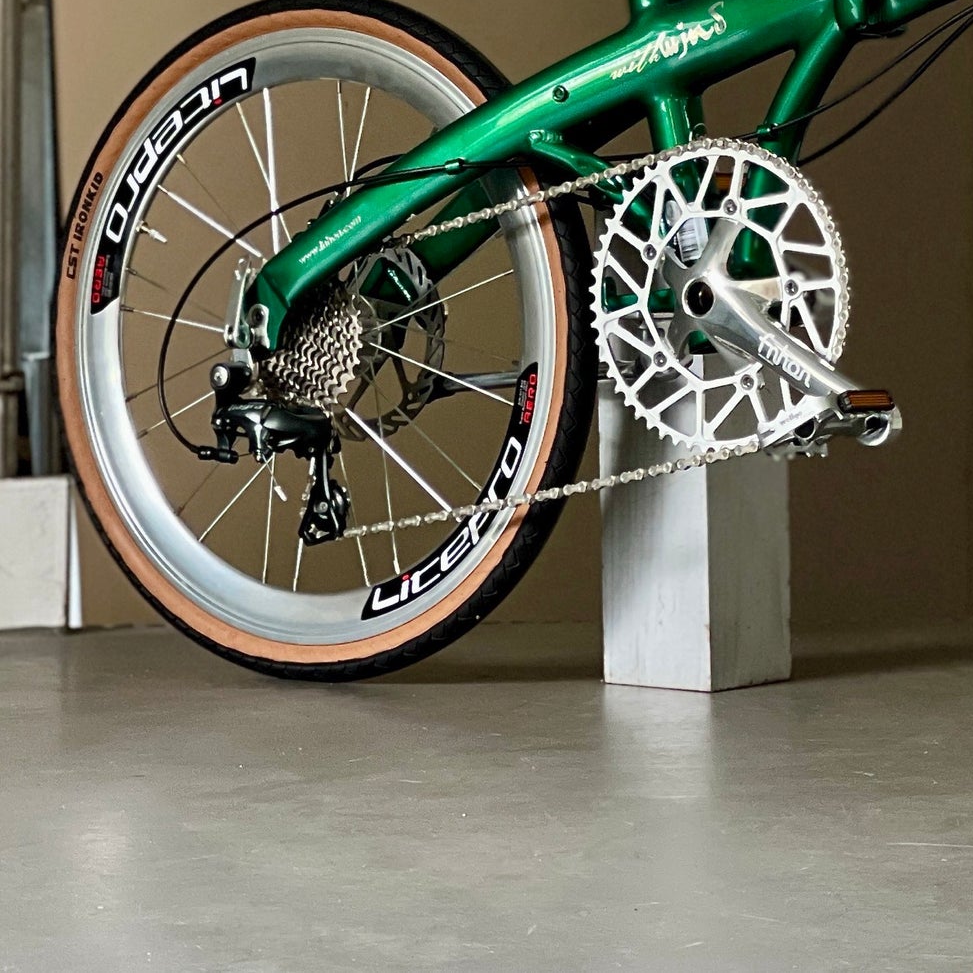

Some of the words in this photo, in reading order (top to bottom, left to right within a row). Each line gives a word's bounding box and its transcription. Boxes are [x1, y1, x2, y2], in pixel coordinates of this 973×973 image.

[66, 243, 80, 279] CST
[73, 171, 104, 242] IRONKID
[523, 373, 537, 425] AERO
